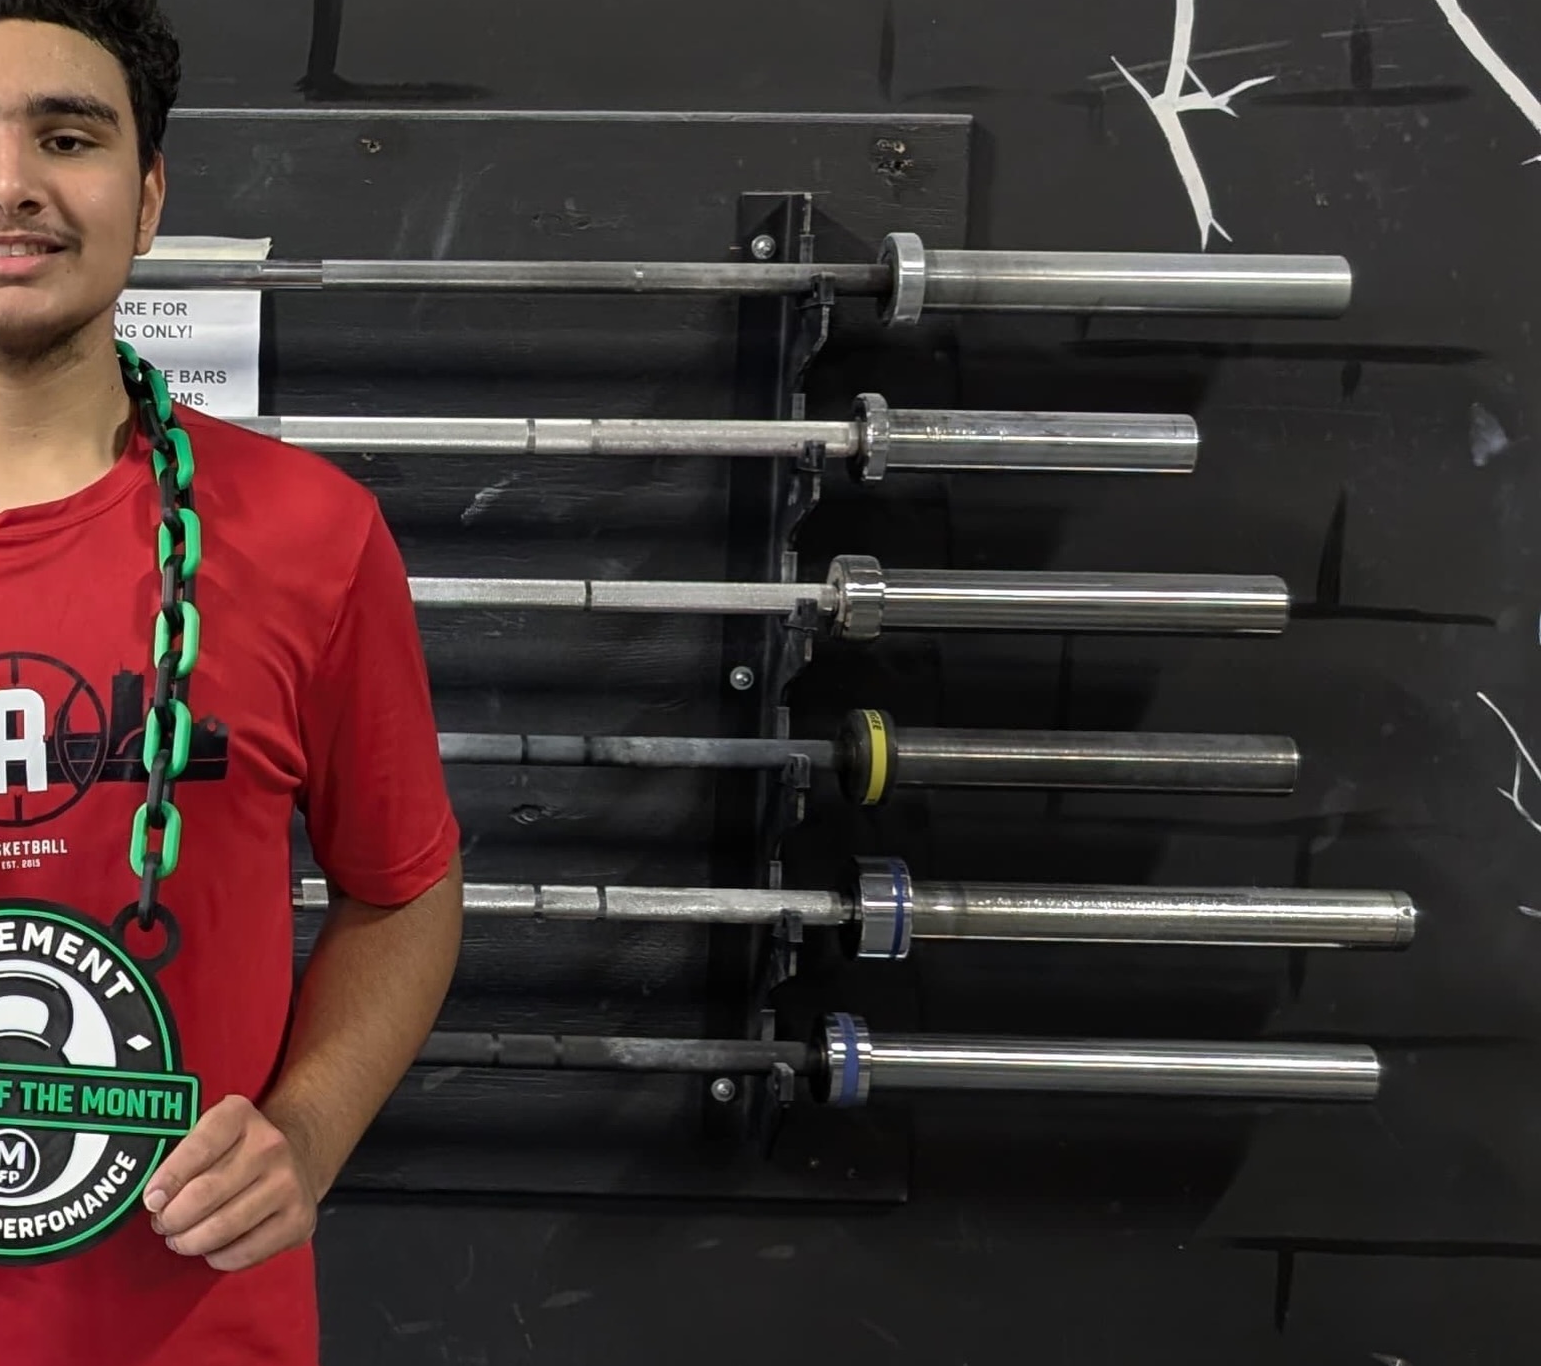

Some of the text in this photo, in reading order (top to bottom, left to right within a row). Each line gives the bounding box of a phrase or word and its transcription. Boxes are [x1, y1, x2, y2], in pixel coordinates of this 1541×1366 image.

[152, 302, 188, 316] FOR
[142, 324, 193, 339] ONLY!
[179, 370, 227, 384] BARS
[1, 860, 19, 870] EST.
[20, 1083, 74, 1114] THE
[81, 1086, 183, 1121] MONTH
